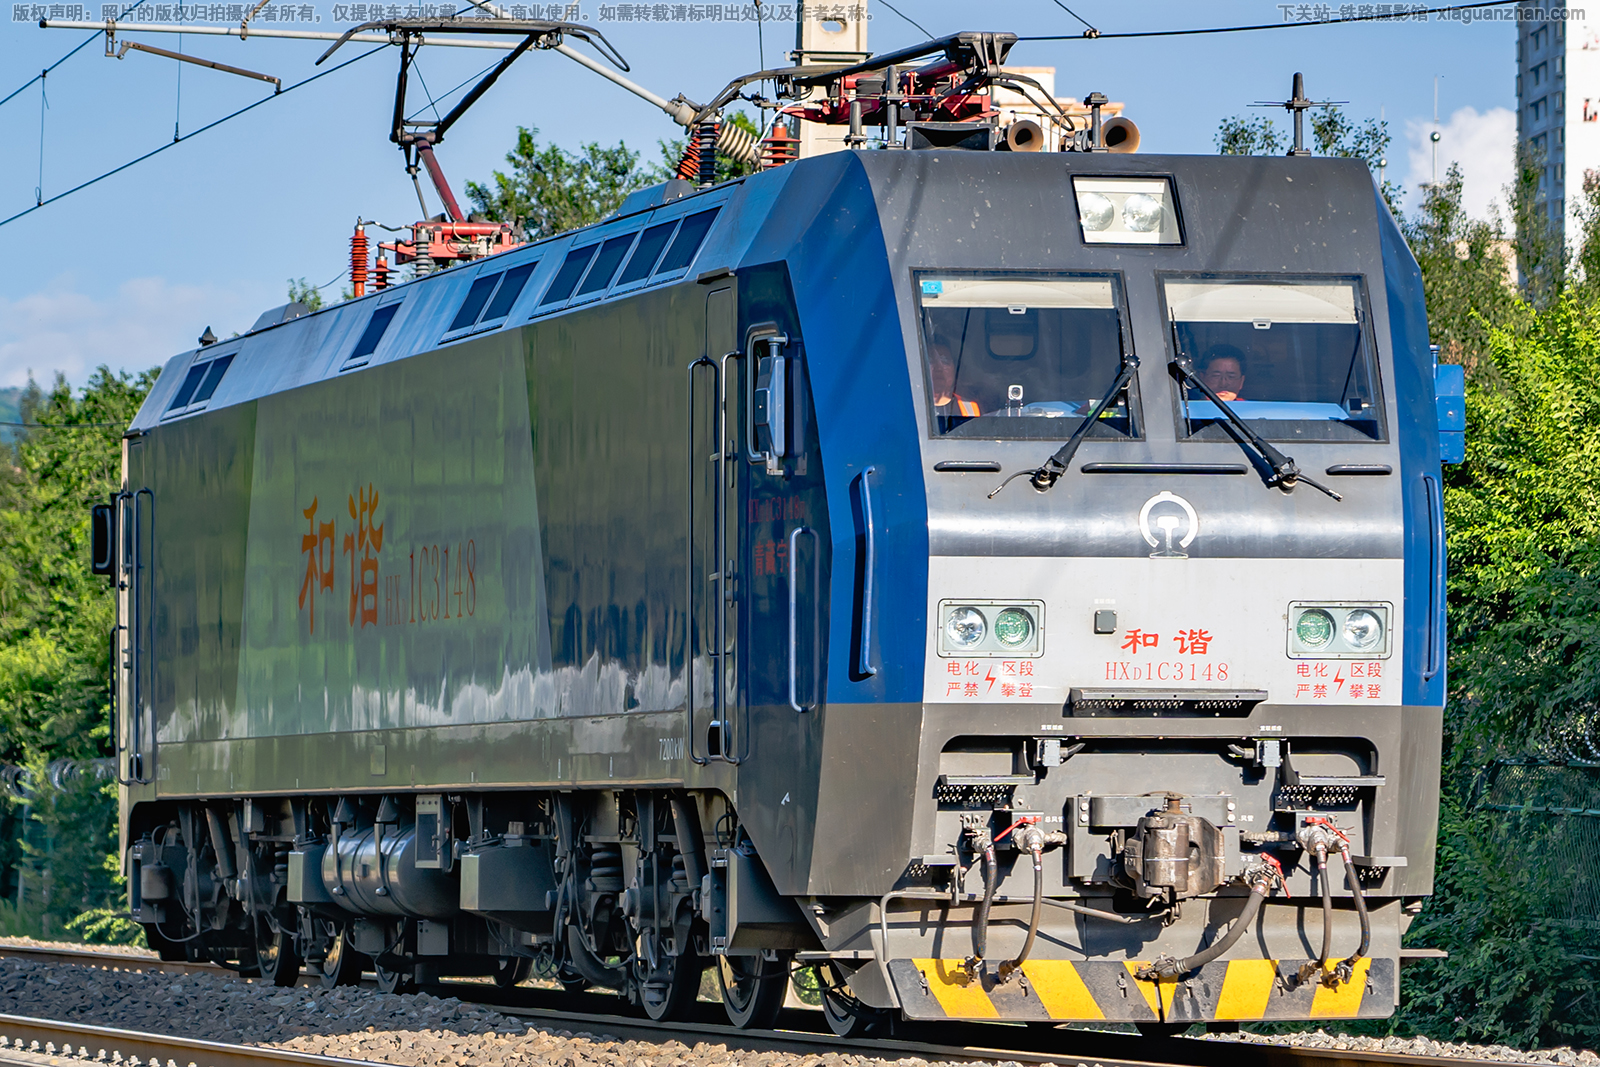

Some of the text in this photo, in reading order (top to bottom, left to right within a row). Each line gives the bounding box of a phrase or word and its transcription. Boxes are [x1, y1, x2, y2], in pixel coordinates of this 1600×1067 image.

[299, 482, 383, 635] 和谐
[755, 539, 798, 576] 青藏宁
[1121, 628, 1213, 655] 和谐
[947, 660, 1034, 676] 电化 区段
[1105, 661, 1229, 681] HXD1C3148
[1296, 662, 1382, 678] 电化 区段
[946, 682, 1033, 697] 严禁 攀登
[1295, 683, 1381, 699] 严禁 攀登
